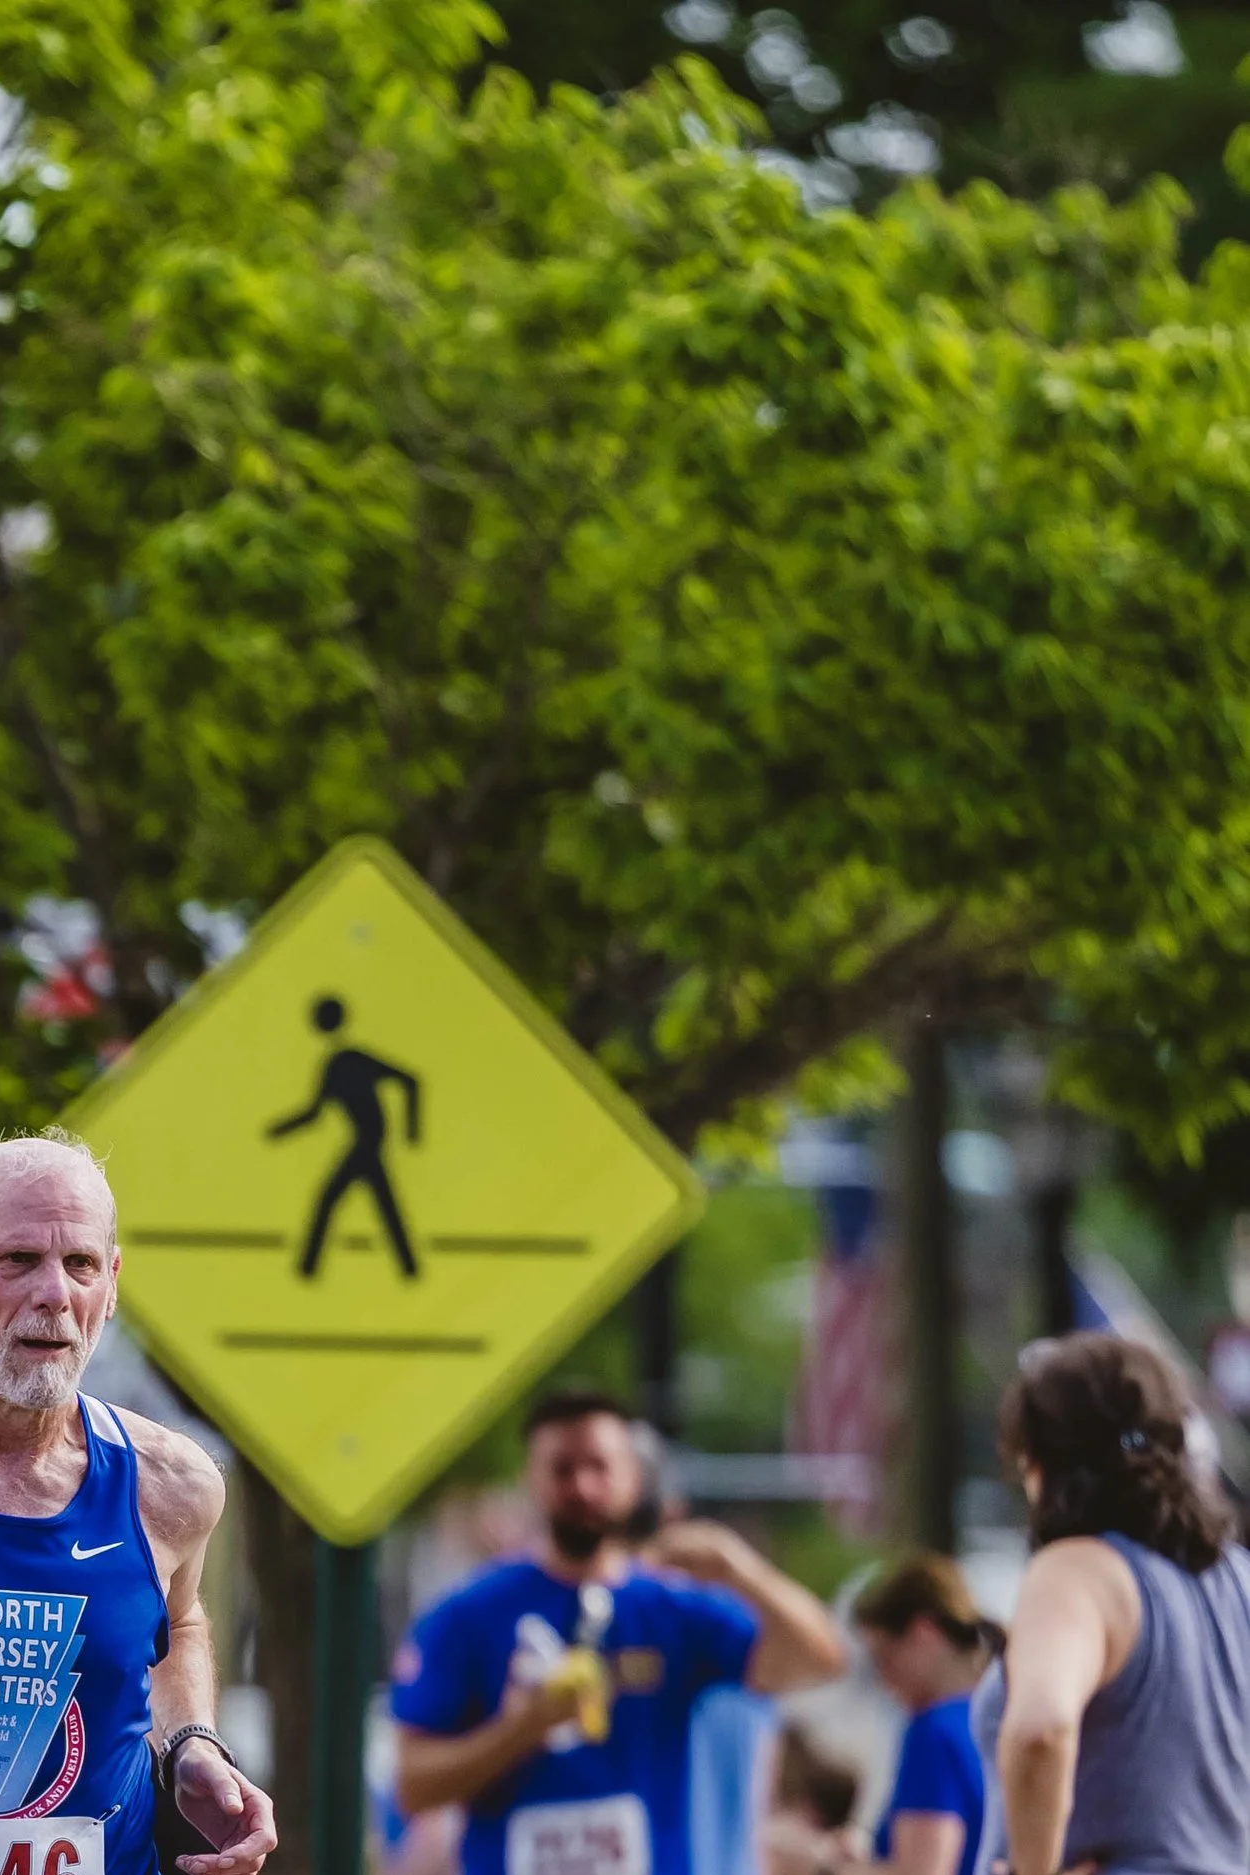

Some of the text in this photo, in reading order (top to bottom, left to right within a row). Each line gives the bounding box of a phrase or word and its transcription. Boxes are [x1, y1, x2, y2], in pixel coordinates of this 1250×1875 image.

[10, 1715, 17, 1727] &
[69, 1713, 79, 1745] CLUB
[62, 1747, 79, 1784] FIELD
[45, 1784, 65, 1807] AND
